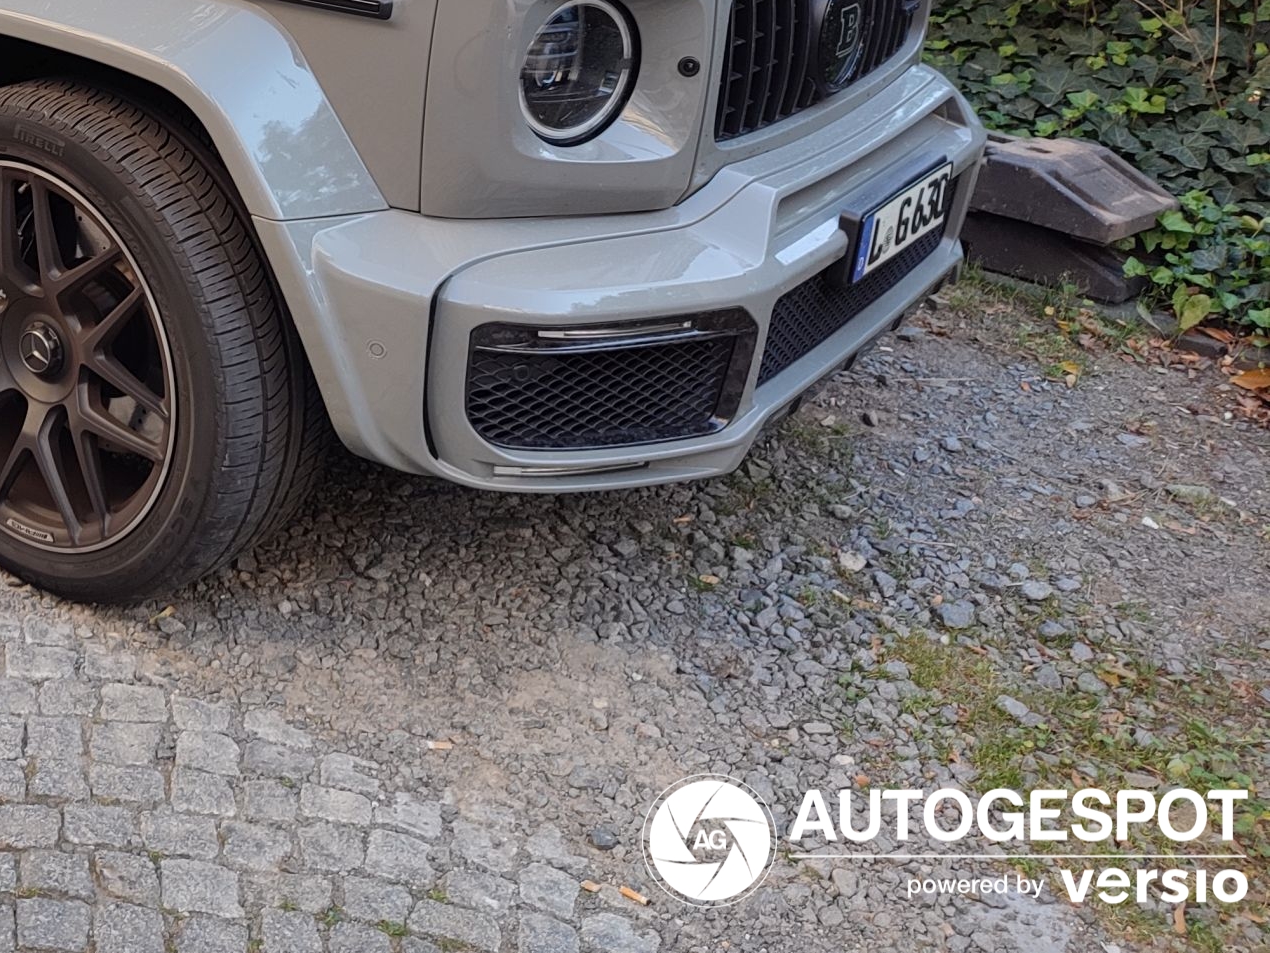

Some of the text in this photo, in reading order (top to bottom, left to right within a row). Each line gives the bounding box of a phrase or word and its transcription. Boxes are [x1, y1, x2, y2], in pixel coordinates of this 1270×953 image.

[835, 3, 861, 58] B
[13, 122, 66, 157] PIRELLI
[867, 217, 884, 266] L
